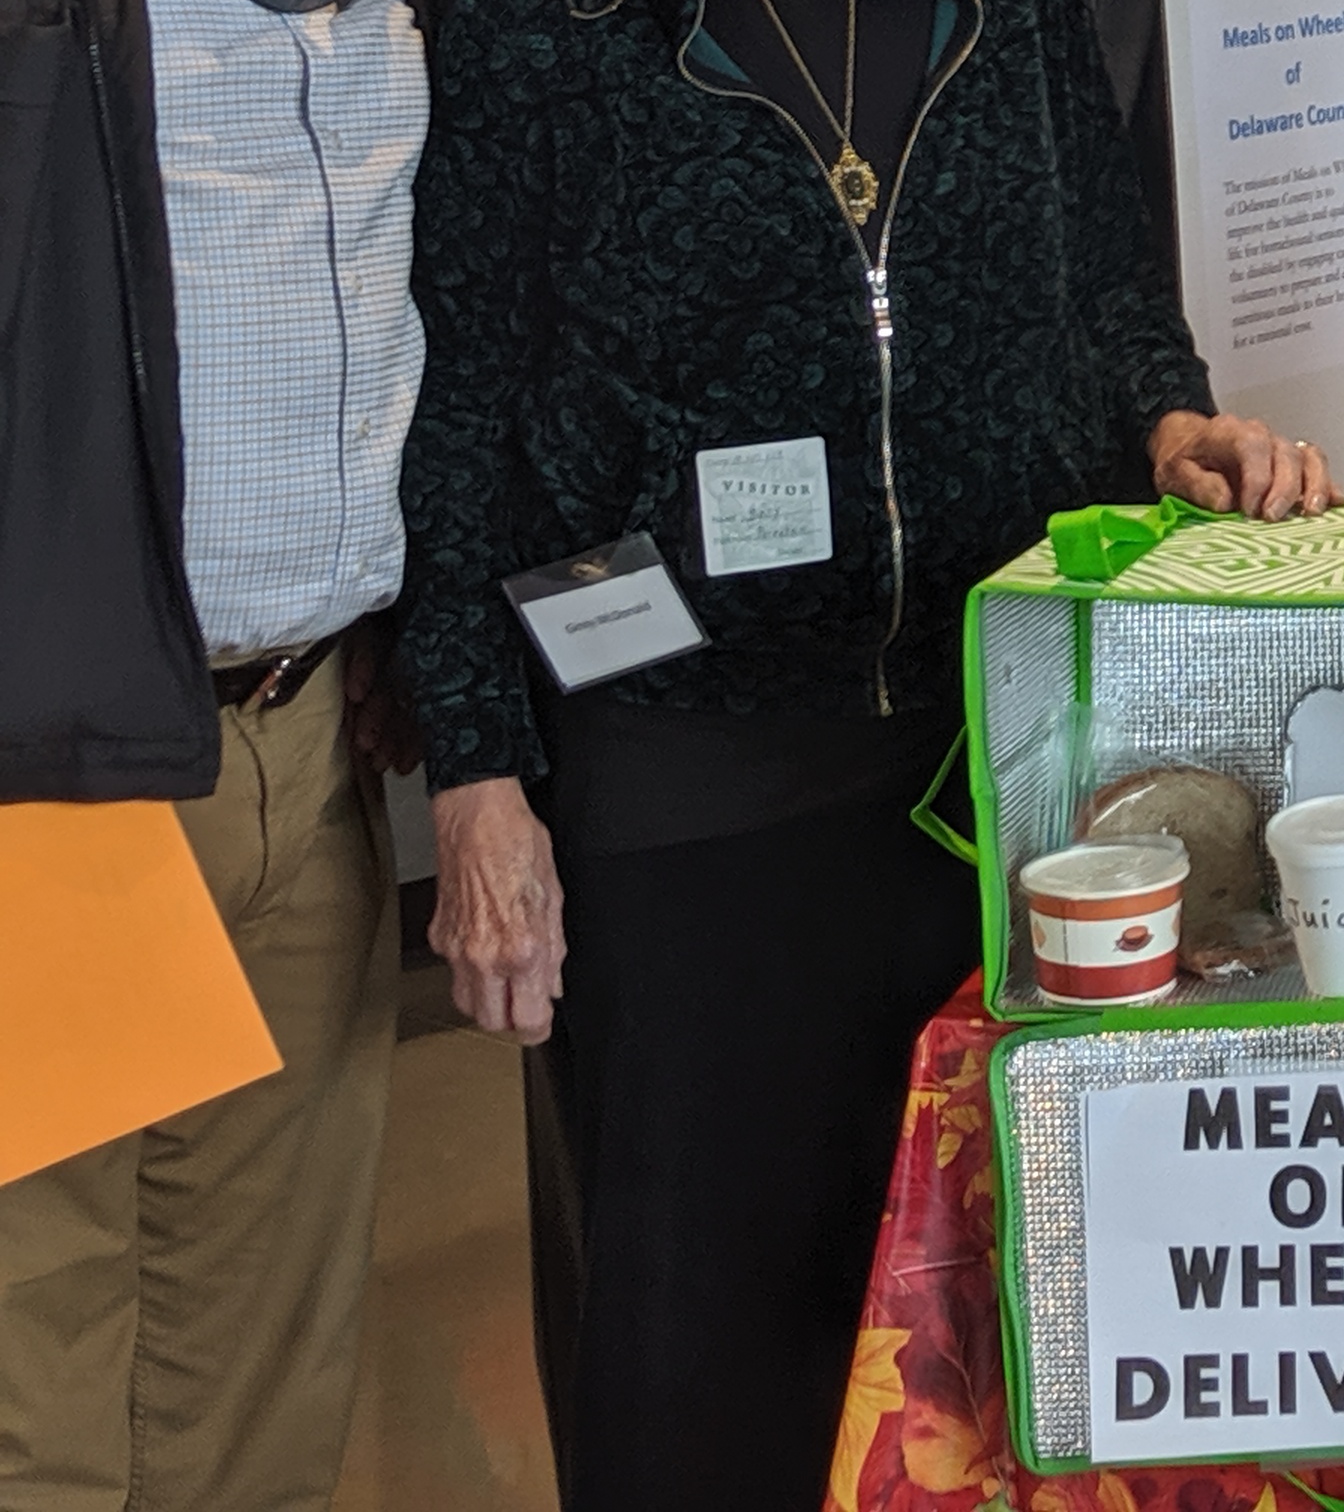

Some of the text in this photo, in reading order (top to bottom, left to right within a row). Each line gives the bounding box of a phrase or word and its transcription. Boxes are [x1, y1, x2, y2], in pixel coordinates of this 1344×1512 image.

[1223, 22, 1271, 49] Meals
[1274, 24, 1295, 41] on
[1286, 61, 1302, 85] of
[1228, 112, 1304, 140] Delaware
[722, 480, 811, 496] VISITOR
